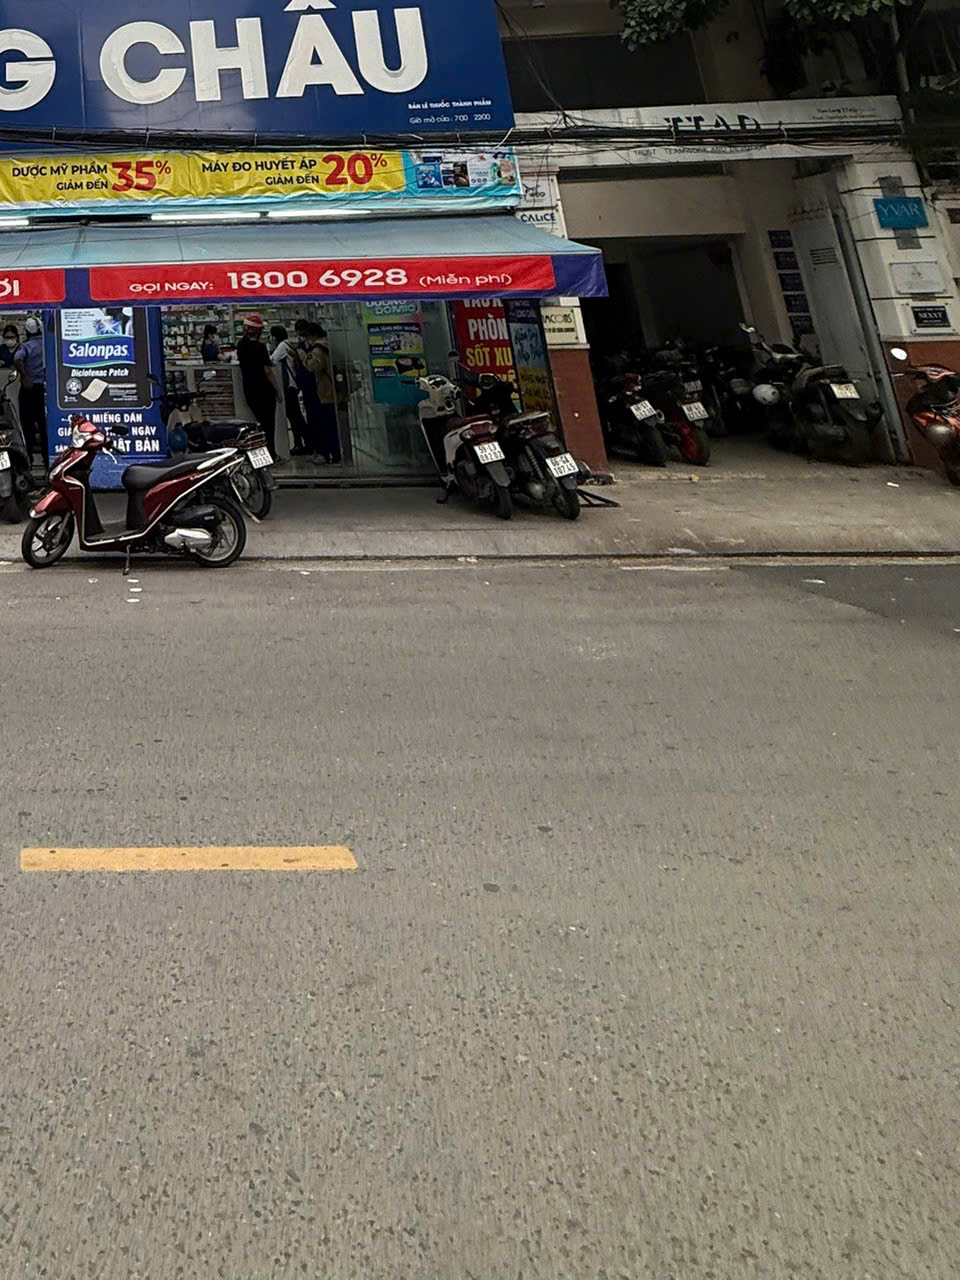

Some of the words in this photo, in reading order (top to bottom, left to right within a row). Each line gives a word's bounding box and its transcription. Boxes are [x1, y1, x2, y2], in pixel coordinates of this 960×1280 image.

[12, 164, 48, 178] DƯỢC
[50, 162, 70, 176] MỸ
[72, 161, 108, 176] PHẨM
[111, 160, 172, 192] 35%
[202, 160, 230, 173] MÁY
[232, 160, 252, 172] ĐO
[255, 157, 296, 170] HUYẾT
[299, 156, 317, 170] ÁP
[321, 152, 388, 186] 20%
[56, 179, 83, 191] GIẢM
[86, 177, 108, 190] ĐẾN
[265, 173, 293, 186] GIẢM
[296, 172, 320, 185] ĐẾN
[129, 282, 162, 294] GỌI
[164, 281, 214, 292] NGAY:
[226, 270, 308, 290] 1800
[319, 267, 408, 288] 6928
[419, 272, 472, 288] (Miễn
[476, 272, 513, 288] phí)
[467, 313, 509, 341] PHÒN
[68, 342, 128, 359] Salonpas
[465, 343, 490, 367] SỐT
[71, 368, 107, 377] Diclofenac
[108, 368, 129, 376] Patch
[92, 411, 121, 423] MIẾNG
[123, 411, 143, 423] DÁN
[131, 425, 157, 436] NGÀY
[135, 436, 160, 452] BẢN
